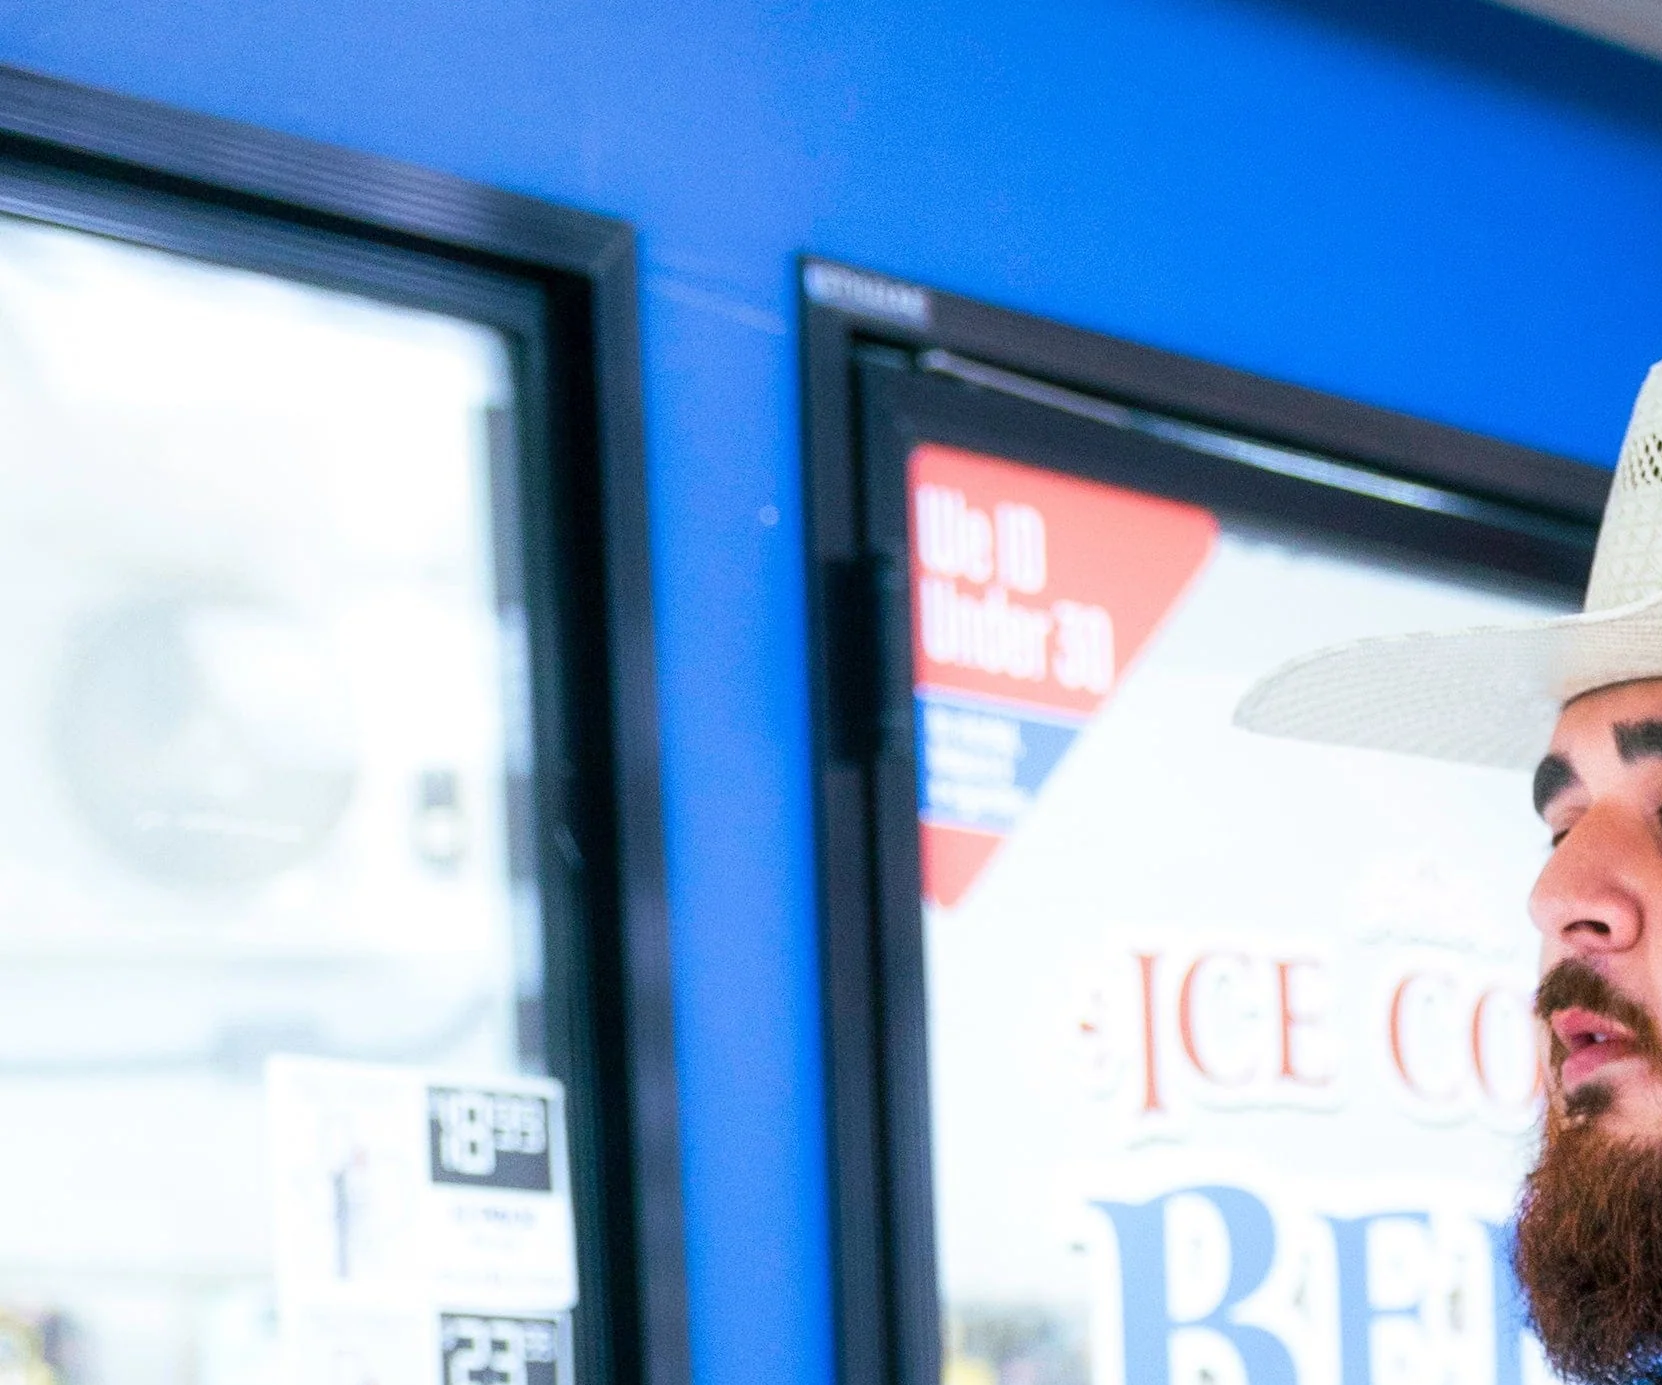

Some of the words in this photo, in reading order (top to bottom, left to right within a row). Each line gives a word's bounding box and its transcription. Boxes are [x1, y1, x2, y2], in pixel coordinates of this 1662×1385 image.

[917, 484, 993, 583] We
[996, 503, 1047, 594] ID
[920, 576, 1053, 682] Under
[1132, 948, 1338, 1113] ICE
[1388, 972, 1548, 1108] CO
